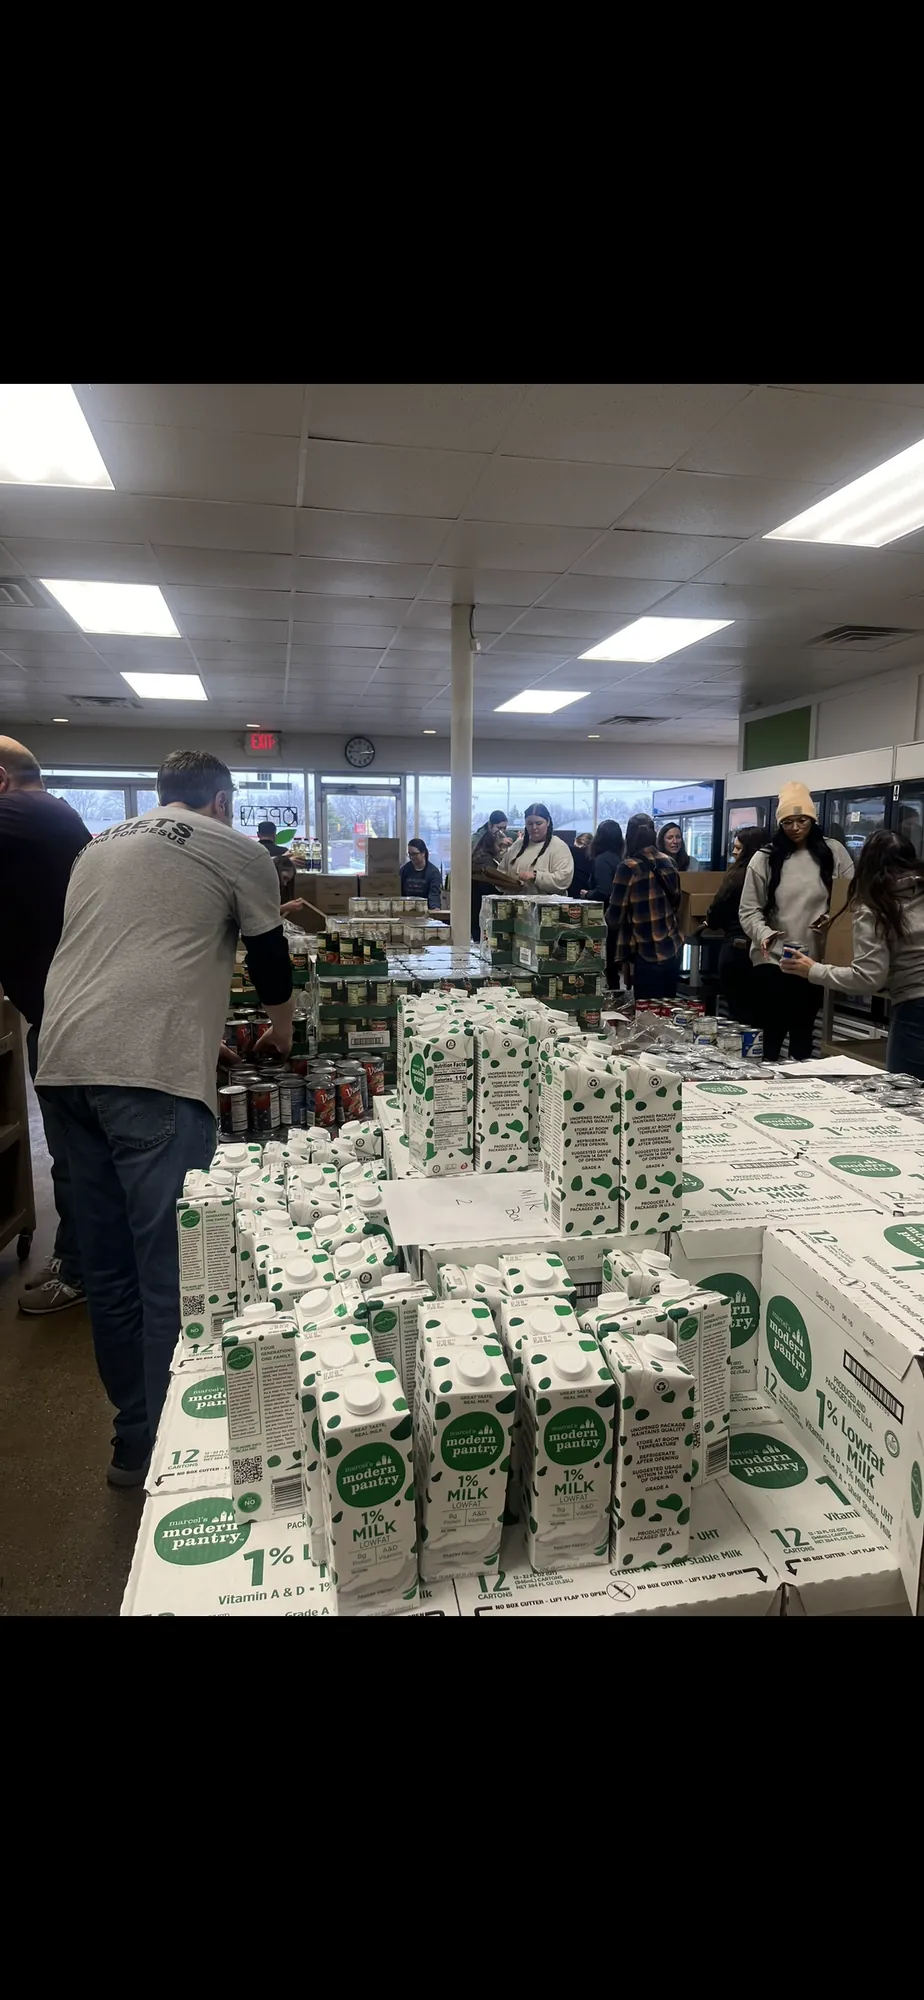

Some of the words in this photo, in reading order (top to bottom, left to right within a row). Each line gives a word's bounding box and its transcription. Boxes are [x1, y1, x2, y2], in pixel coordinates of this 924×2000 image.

[250, 733, 273, 750] EXIT
[93, 818, 194, 839] ADETS
[112, 830, 137, 839] FOR
[141, 827, 187, 845] JESUS
[709, 1187, 746, 1201] 1%
[748, 1183, 810, 1193] Lowfat
[767, 1191, 810, 1200] Milk
[809, 1230, 838, 1243] 12
[769, 1318, 806, 1363] modern
[773, 1337, 808, 1379] pantry
[764, 1365, 778, 1398] 12
[350, 1425, 368, 1434] GREAT
[630, 1424, 659, 1433] UNOPENED
[815, 1388, 838, 1430] 1%
[841, 1415, 886, 1477] Lowfat
[446, 1436, 496, 1446] modern
[549, 1430, 598, 1441] modern
[452, 1445, 498, 1458] pantry
[556, 1439, 600, 1452] pantry
[639, 1442, 676, 1450] TEMPERATURE
[171, 1448, 200, 1465] 12
[640, 1451, 675, 1459] REFRIGERATE
[730, 1453, 791, 1466] modern
[345, 1461, 374, 1472] marcel's
[632, 1466, 663, 1475] SUGGESTED
[743, 1462, 799, 1476] pantry
[805, 1417, 826, 1447] Vitamin
[826, 1442, 830, 1453] A
[835, 1453, 840, 1464] D
[854, 1477, 875, 1505] Milkfat
[880, 1504, 894, 1525] UHT
[847, 1443, 876, 1489] Milk
[342, 1465, 397, 1485] modern
[458, 1474, 478, 1487] 1%
[564, 1468, 584, 1481] 1%
[351, 1474, 400, 1496] pantry
[554, 1480, 595, 1497] MILK
[447, 1486, 489, 1502] MILK
[560, 1495, 588, 1503] LOWFAT
[822, 1454, 838, 1477] Grade
[847, 1483, 862, 1504] Shelf
[861, 1499, 880, 1526] Stable
[879, 1520, 892, 1541] Milk
[452, 1501, 481, 1509] LOWFAT
[169, 1517, 208, 1526] marcel's
[361, 1508, 385, 1526] 1%
[824, 1510, 861, 1522] Vitami
[161, 1522, 239, 1539] modern
[287, 1521, 307, 1530] PACK
[352, 1519, 397, 1543] MILK
[638, 1528, 667, 1536] PRODUCED
[171, 1532, 242, 1551] pantry
[629, 1533, 658, 1542] PACKAGED
[697, 1529, 720, 1541] UHT
[770, 1527, 810, 1548] 12
[359, 1537, 391, 1549] LOWFAT
[382, 1544, 398, 1553] A&D
[783, 1546, 814, 1554] CARTONS
[687, 1553, 720, 1565] Stable
[720, 1549, 742, 1559] Milk
[243, 1545, 294, 1587] 1%
[478, 1570, 510, 1593] 12
[218, 1592, 267, 1605] Vitamin
[271, 1589, 280, 1598] A
[283, 1588, 293, 1597] &
[296, 1586, 305, 1596] D
[478, 1591, 513, 1600] CARTONS
